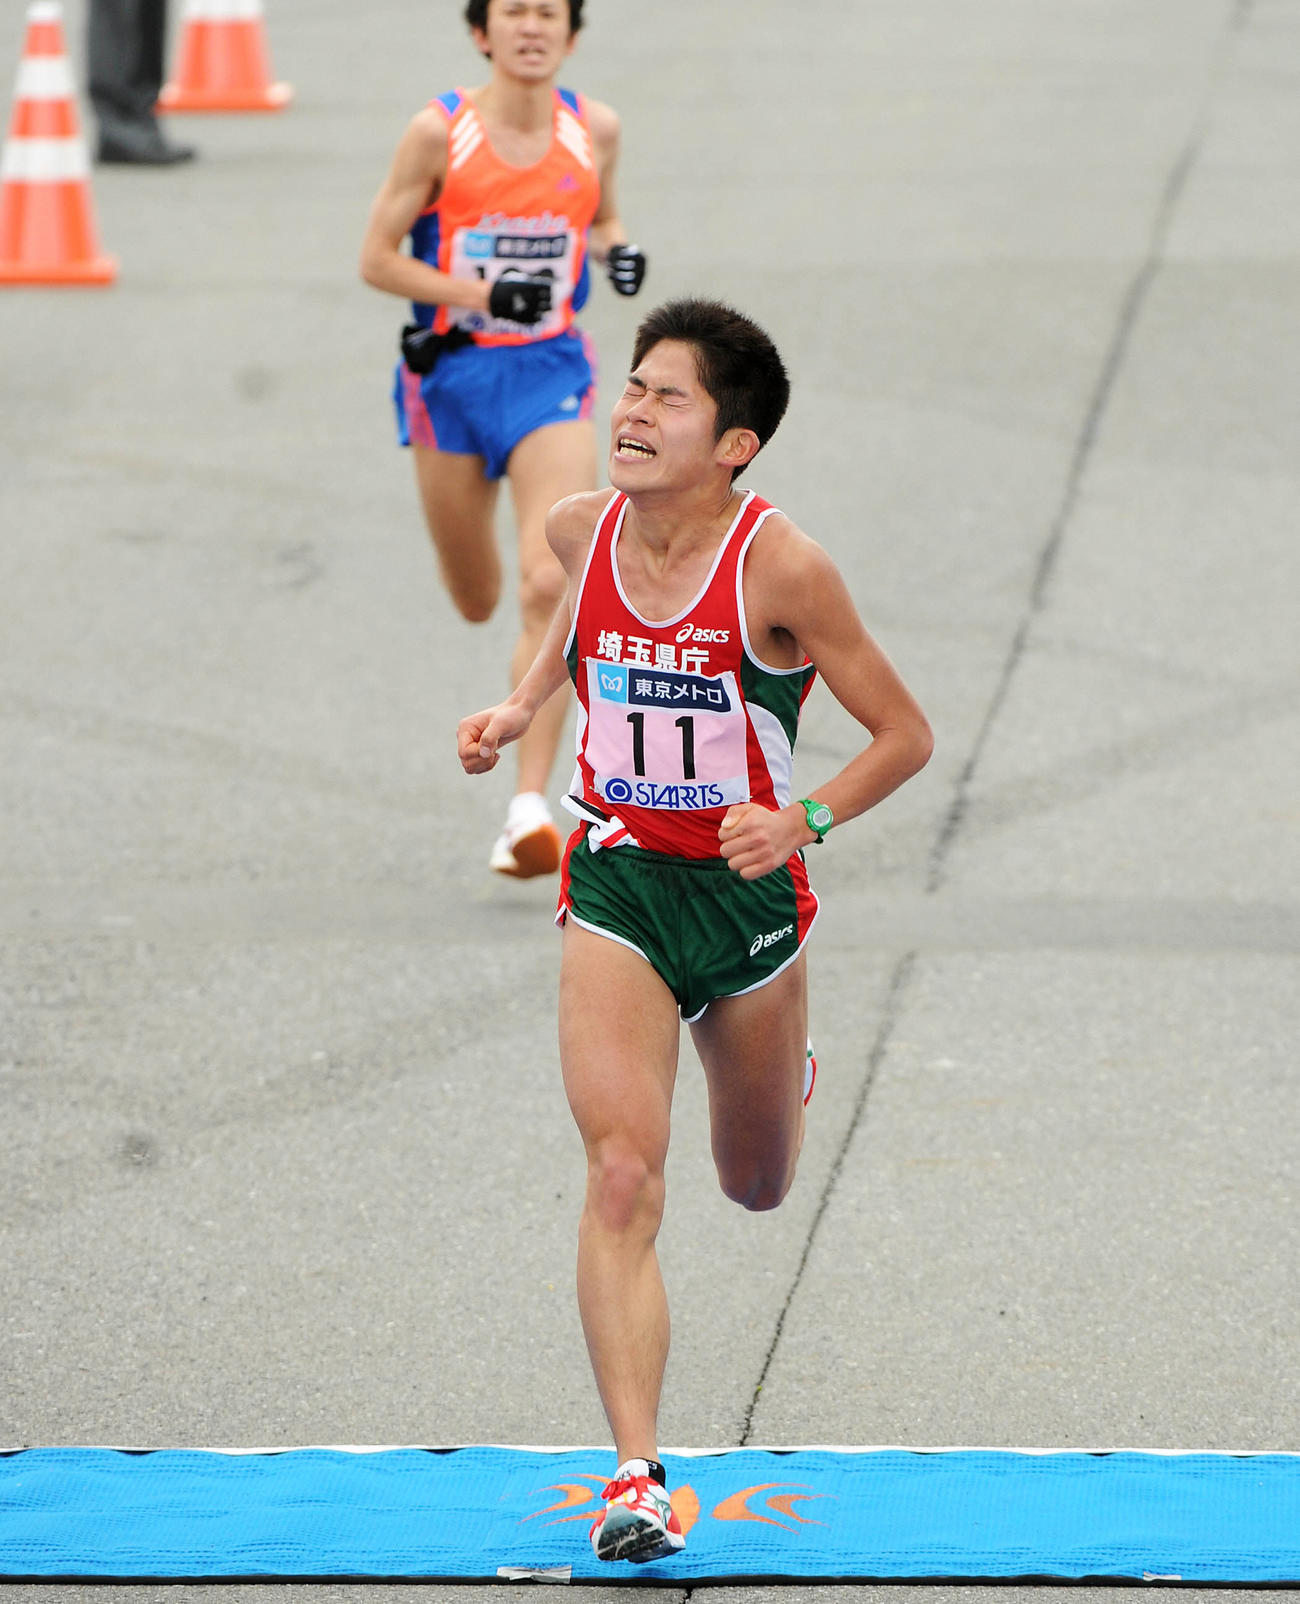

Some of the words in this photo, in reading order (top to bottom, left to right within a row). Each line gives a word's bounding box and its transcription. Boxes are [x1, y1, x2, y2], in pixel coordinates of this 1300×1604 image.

[597, 629, 710, 675] 埼玉県庁
[635, 678, 723, 704] 東京メトロ
[627, 712, 697, 780] 11
